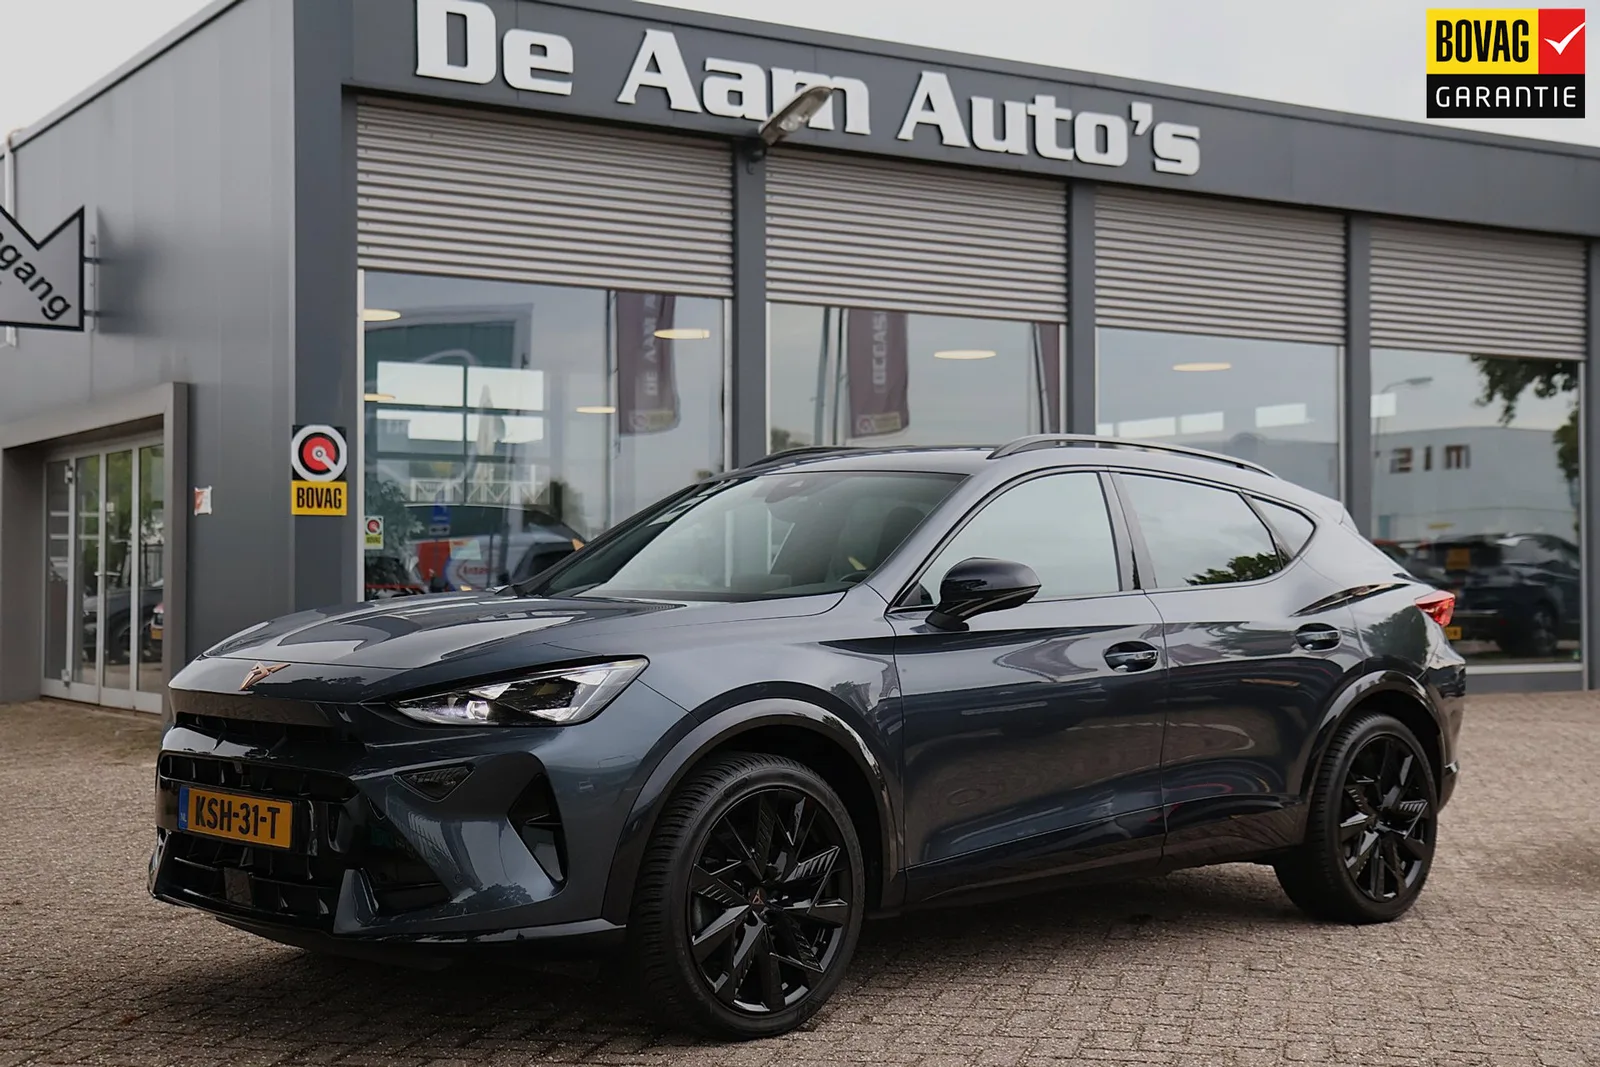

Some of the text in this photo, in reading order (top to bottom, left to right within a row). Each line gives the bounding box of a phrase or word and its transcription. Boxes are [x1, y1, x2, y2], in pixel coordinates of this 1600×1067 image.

[415, 0, 1201, 177] De Aam Auto's
[0, 232, 72, 321] gang
[296, 486, 342, 509] BOVAG
[195, 795, 281, 839] KSH-31-T
